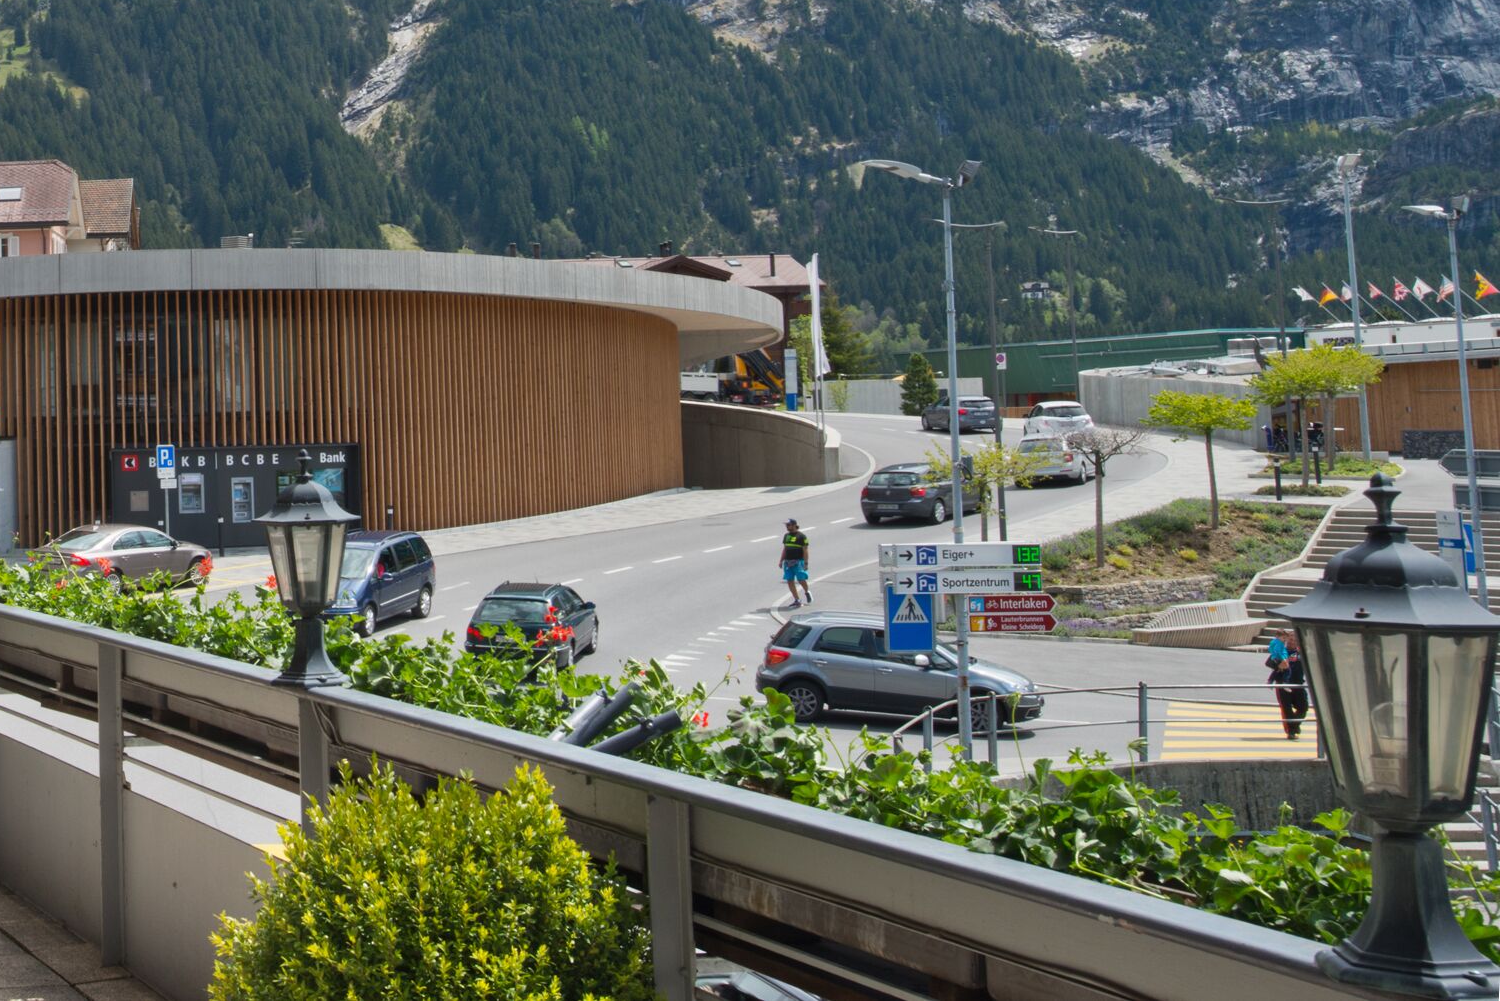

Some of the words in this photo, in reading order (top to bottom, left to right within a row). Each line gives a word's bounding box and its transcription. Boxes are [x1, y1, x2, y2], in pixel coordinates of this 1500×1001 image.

[226, 454, 280, 466] BCBE
[320, 451, 346, 463] Bank
[942, 549, 974, 561] Eiger+
[1017, 547, 1040, 562] 132
[942, 577, 1010, 589] Sportzentrum
[1022, 574, 1041, 589] 47
[1000, 597, 1048, 609] Interlaken
[1001, 615, 1044, 623] Lauterbrunnen
[1019, 623, 1046, 631] Scheidegg
